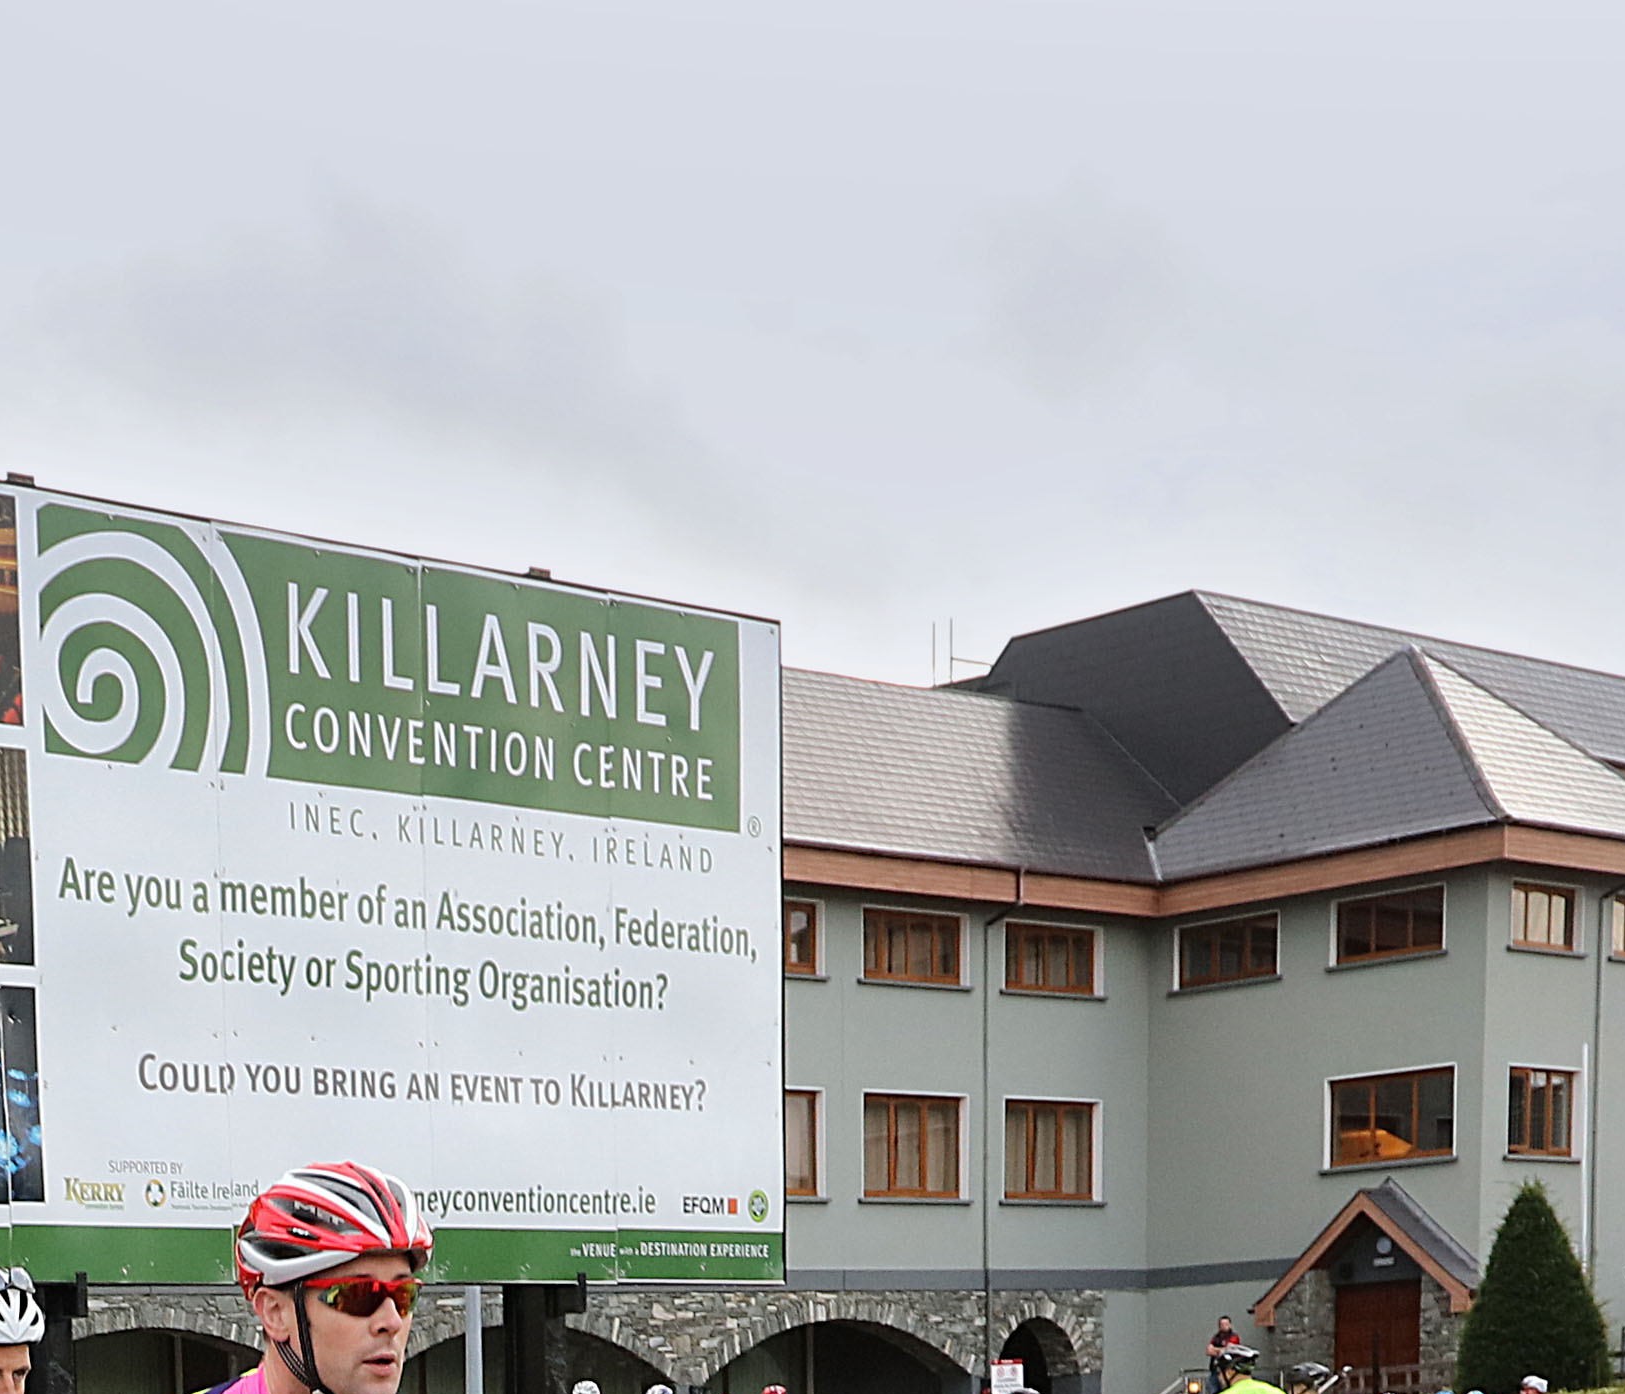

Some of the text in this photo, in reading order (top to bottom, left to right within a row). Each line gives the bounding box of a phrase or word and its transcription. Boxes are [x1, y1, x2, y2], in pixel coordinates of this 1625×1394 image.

[286, 581, 716, 731] KILLARNEY
[284, 702, 714, 801] CONVENTION CENTRE
[592, 836, 713, 874] IRELAND
[59, 857, 758, 963] Are you a member of an Association, Federation,
[179, 938, 669, 1012] Society or Sporting Organisation?
[245, 1063, 301, 1095] YOU
[313, 1066, 396, 1099] BRING
[406, 1072, 440, 1101] AN
[450, 1073, 523, 1105] EVENT
[530, 1077, 561, 1106] TO
[108, 1160, 184, 1175] SUPPORTED BY
[64, 1177, 126, 1204] KERRY
[170, 1180, 260, 1201] Fáilte Ireland
[682, 1195, 726, 1215] EFQM
[582, 1241, 617, 1259] VENUE
[640, 1242, 708, 1258] DESTINATION
[710, 1243, 770, 1260] EXPERIENCE
